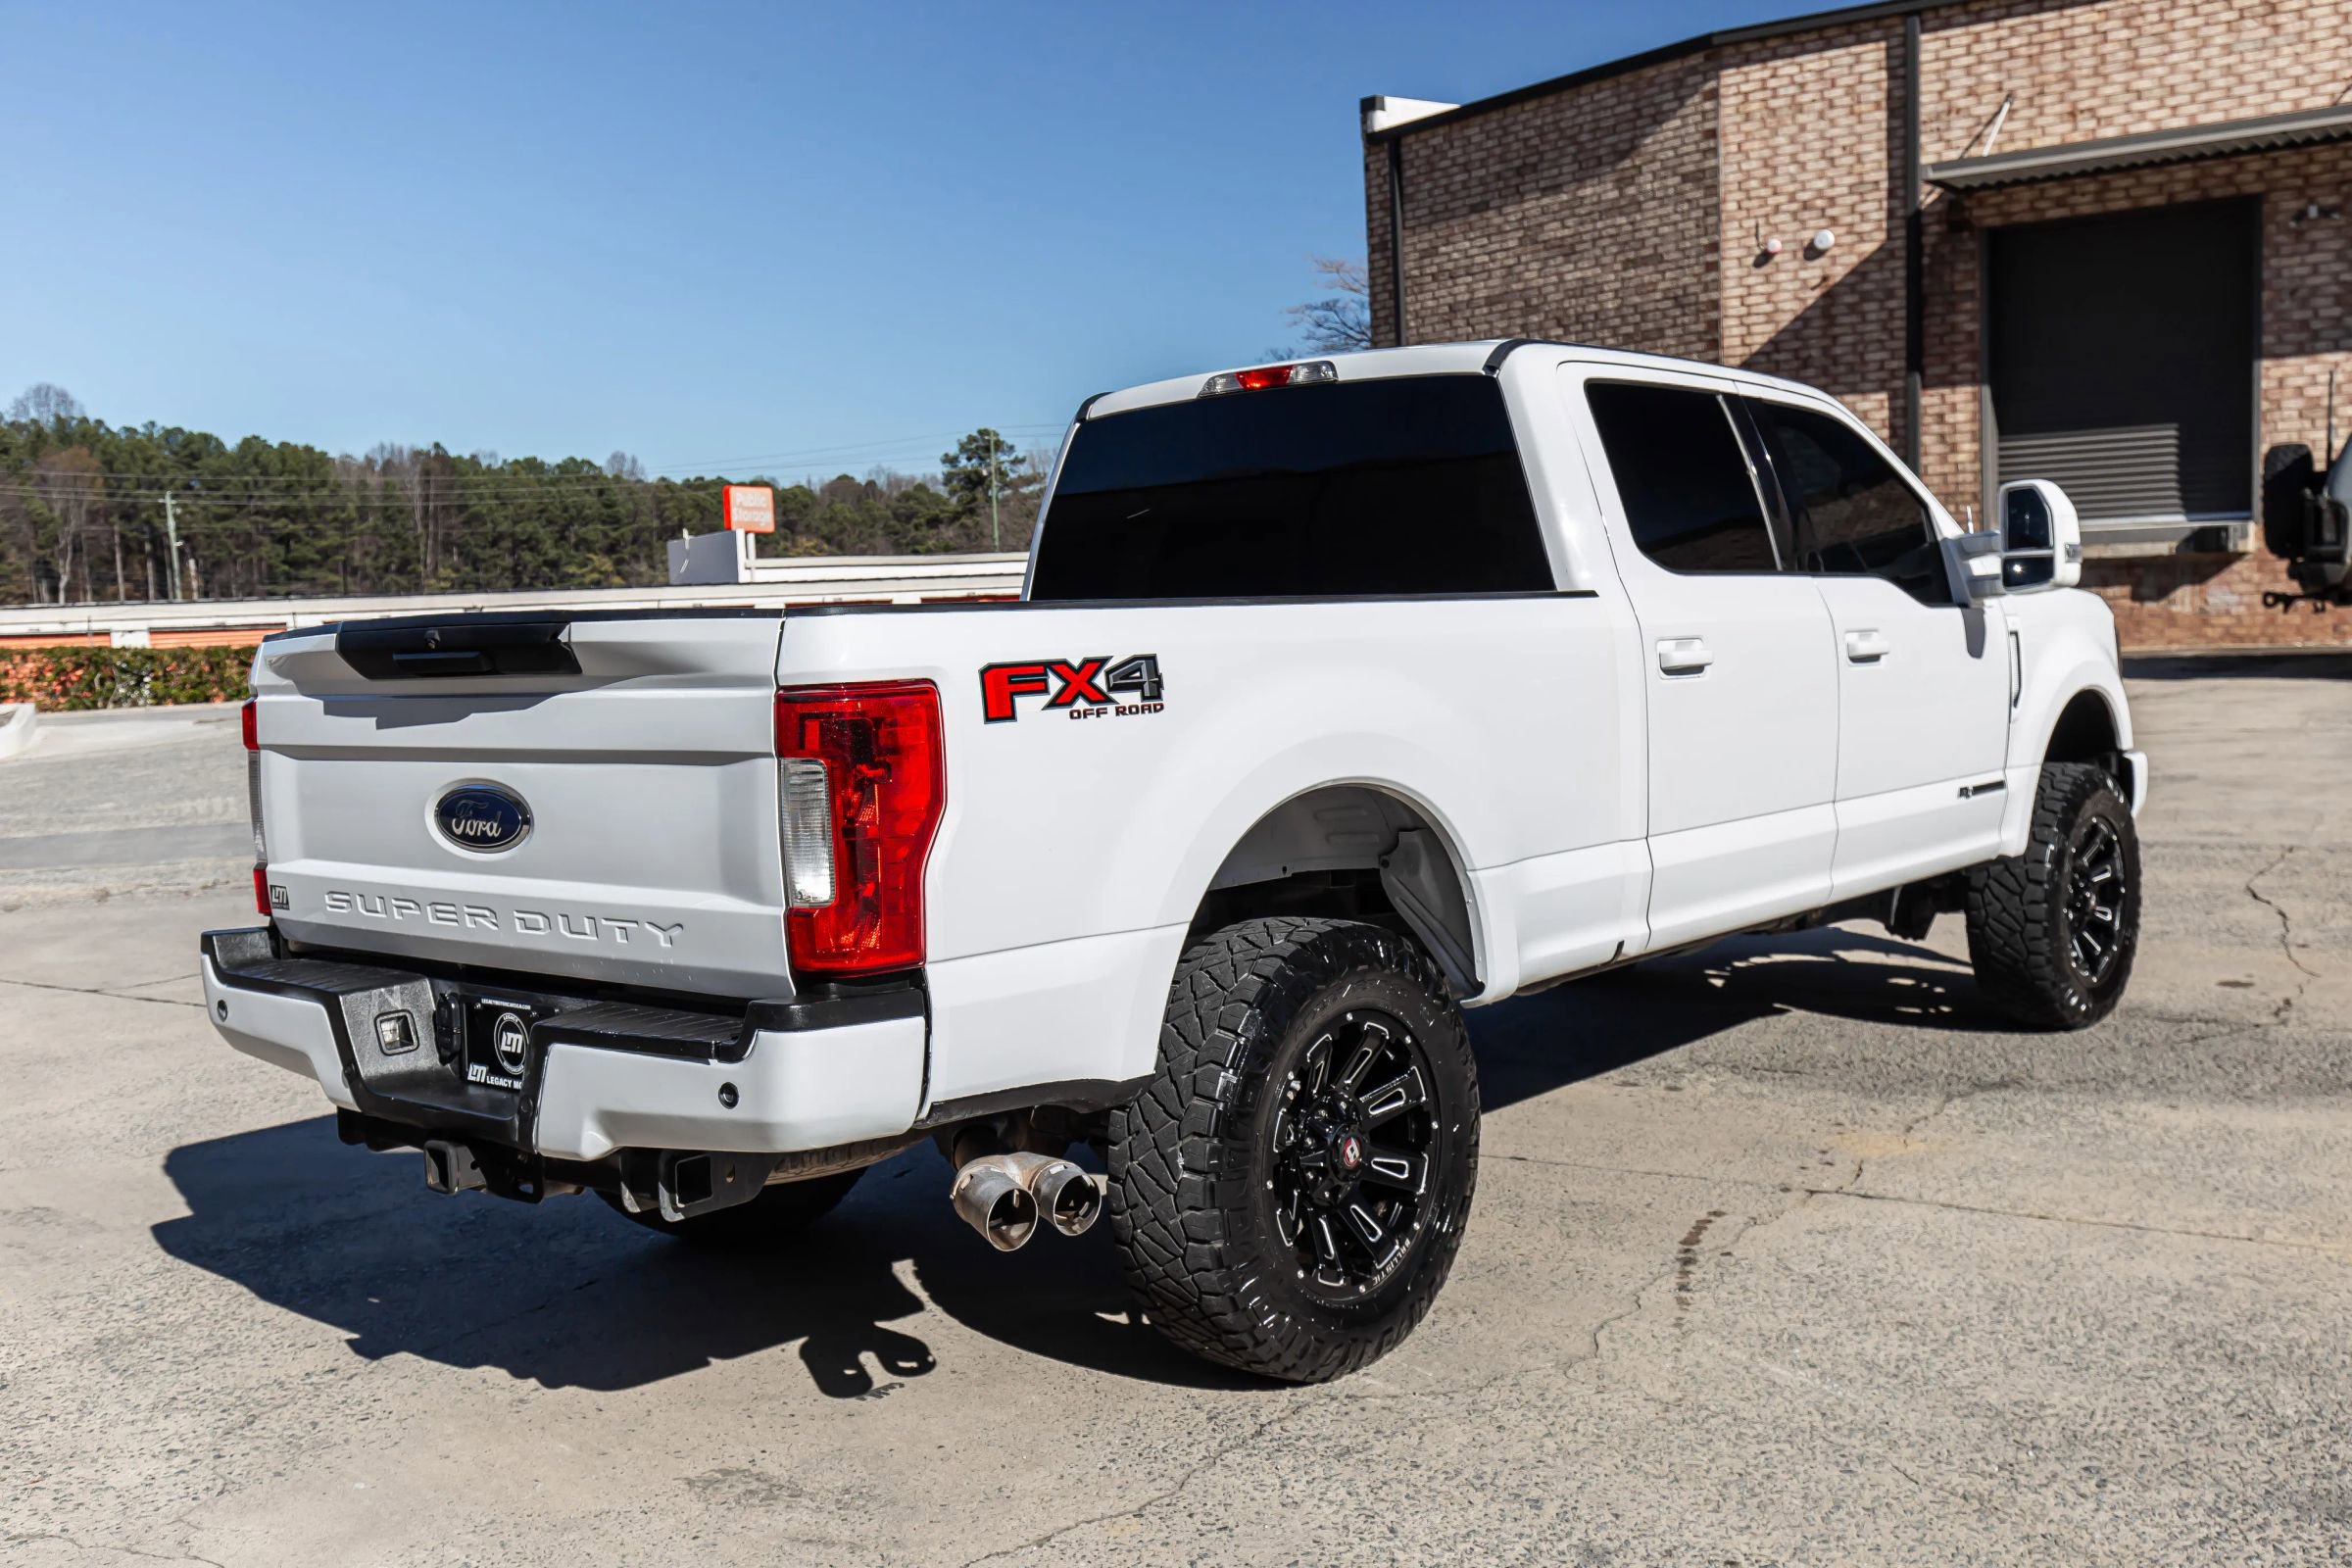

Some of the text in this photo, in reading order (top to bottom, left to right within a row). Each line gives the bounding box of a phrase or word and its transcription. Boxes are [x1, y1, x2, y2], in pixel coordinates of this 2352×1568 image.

[978, 654, 1164, 724] FX4
[1069, 703, 1165, 720] OFF ROAD
[452, 800, 502, 838] Ford
[324, 890, 684, 948] SUPER DUTY
[486, 1075, 513, 1088] LEGACY
[1372, 1238, 1411, 1286] BALLISTIC
